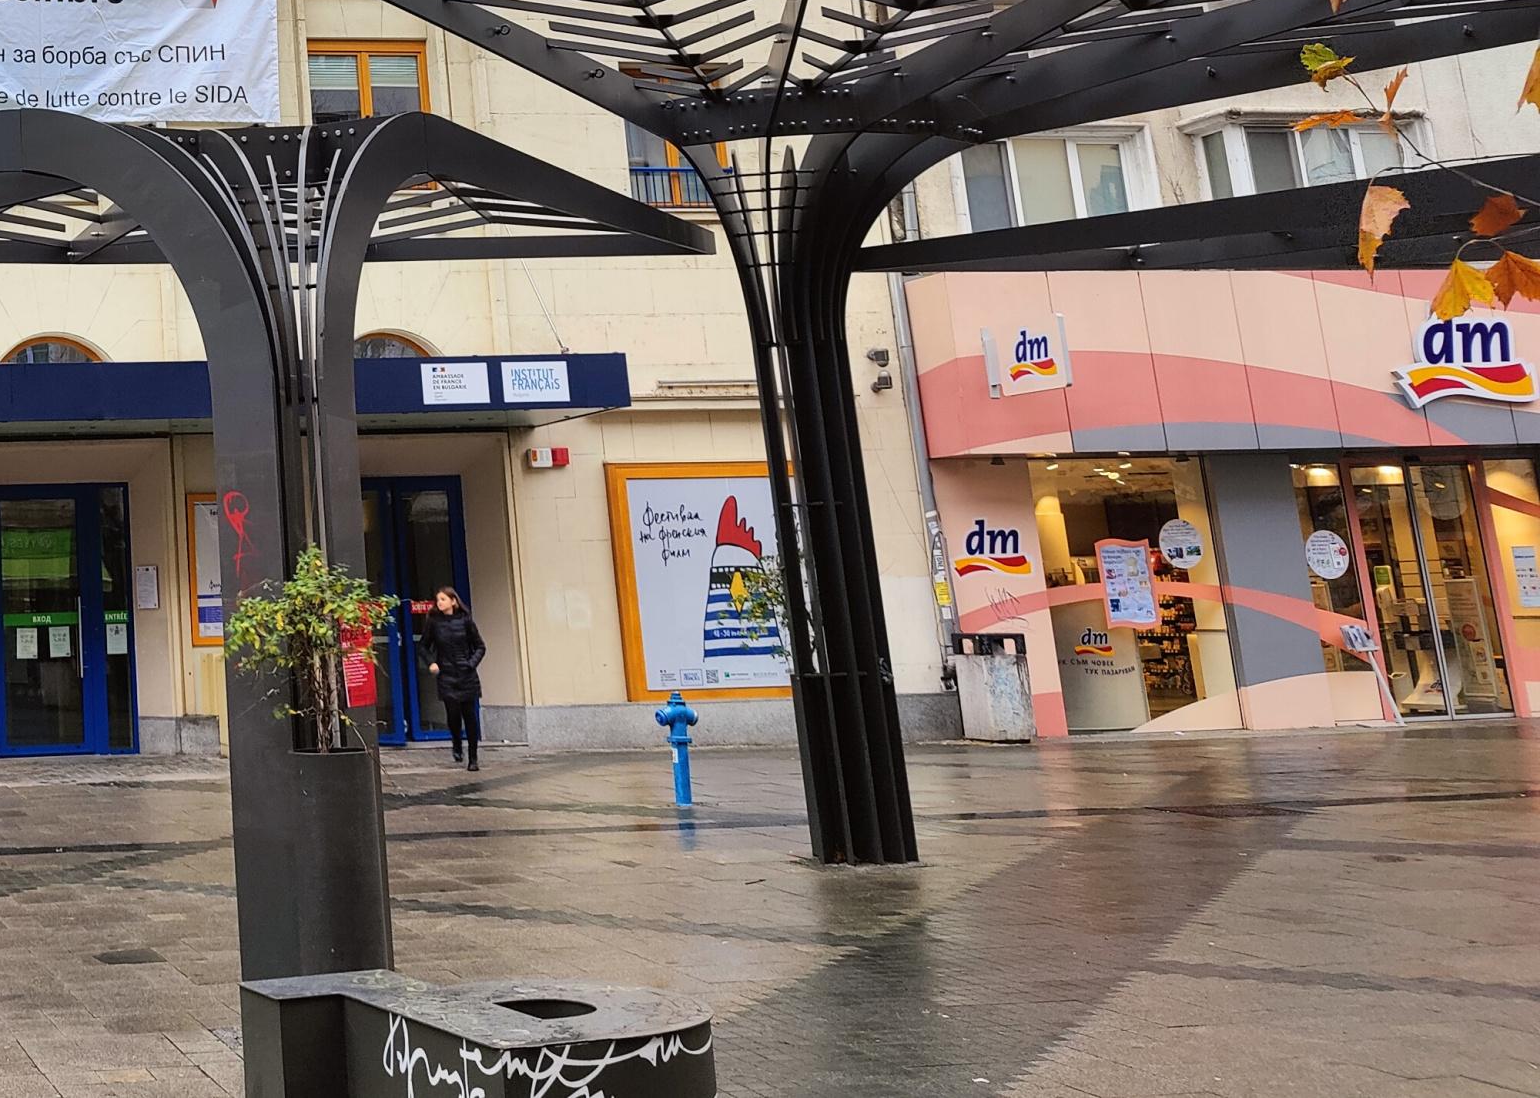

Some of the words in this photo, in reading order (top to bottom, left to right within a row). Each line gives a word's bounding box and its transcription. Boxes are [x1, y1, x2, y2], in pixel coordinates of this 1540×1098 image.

[12, 47, 36, 63] за
[42, 45, 107, 68] борба
[114, 48, 152, 64] със
[158, 43, 226, 63] СПИН
[15, 89, 39, 108] de
[45, 90, 90, 108] lutte
[97, 89, 161, 106] contre
[169, 88, 187, 104] le
[195, 85, 249, 104] SIDA
[1014, 330, 1049, 364] dm
[1423, 319, 1510, 365] dm
[511, 368, 554, 380] INSTITUT
[642, 501, 703, 530] Фестивал
[965, 519, 1019, 556] dm
[661, 548, 691, 566] филм
[32, 615, 52, 624] ВХОД
[104, 612, 128, 621] ENTRÉE
[1081, 628, 1108, 645] dm
